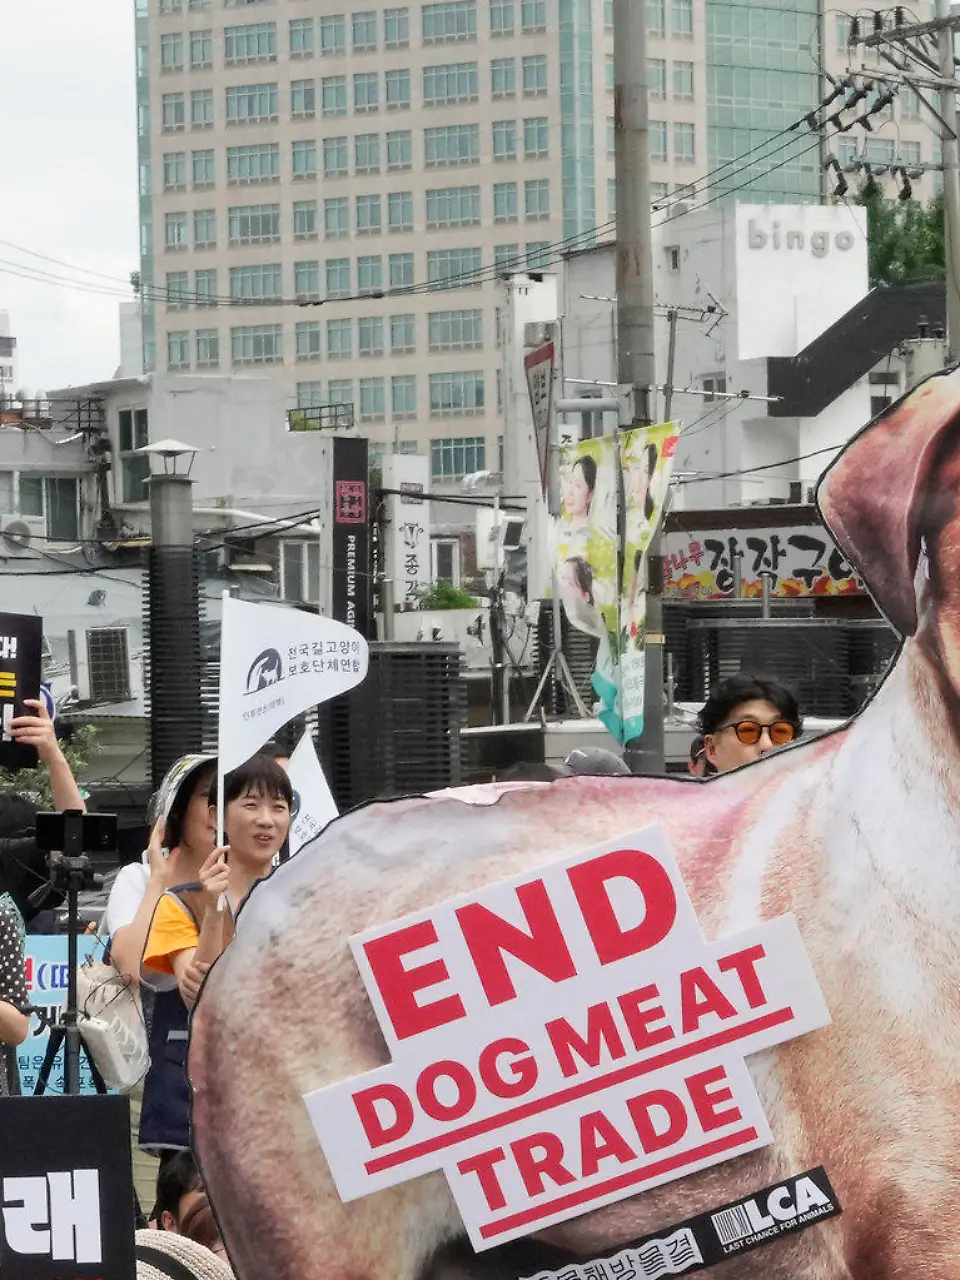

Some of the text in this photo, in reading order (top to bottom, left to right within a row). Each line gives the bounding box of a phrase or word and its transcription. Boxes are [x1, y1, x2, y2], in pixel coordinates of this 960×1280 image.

[748, 219, 855, 259] bingo
[347, 534, 357, 628] PREMIUM AGI
[361, 848, 678, 1041] END
[351, 943, 767, 1149] DOG MEAT
[456, 1064, 744, 1213] TRADE
[723, 1202, 835, 1254] LAST CHANCE FOR ANIMALS
[743, 1176, 831, 1233] LCA
